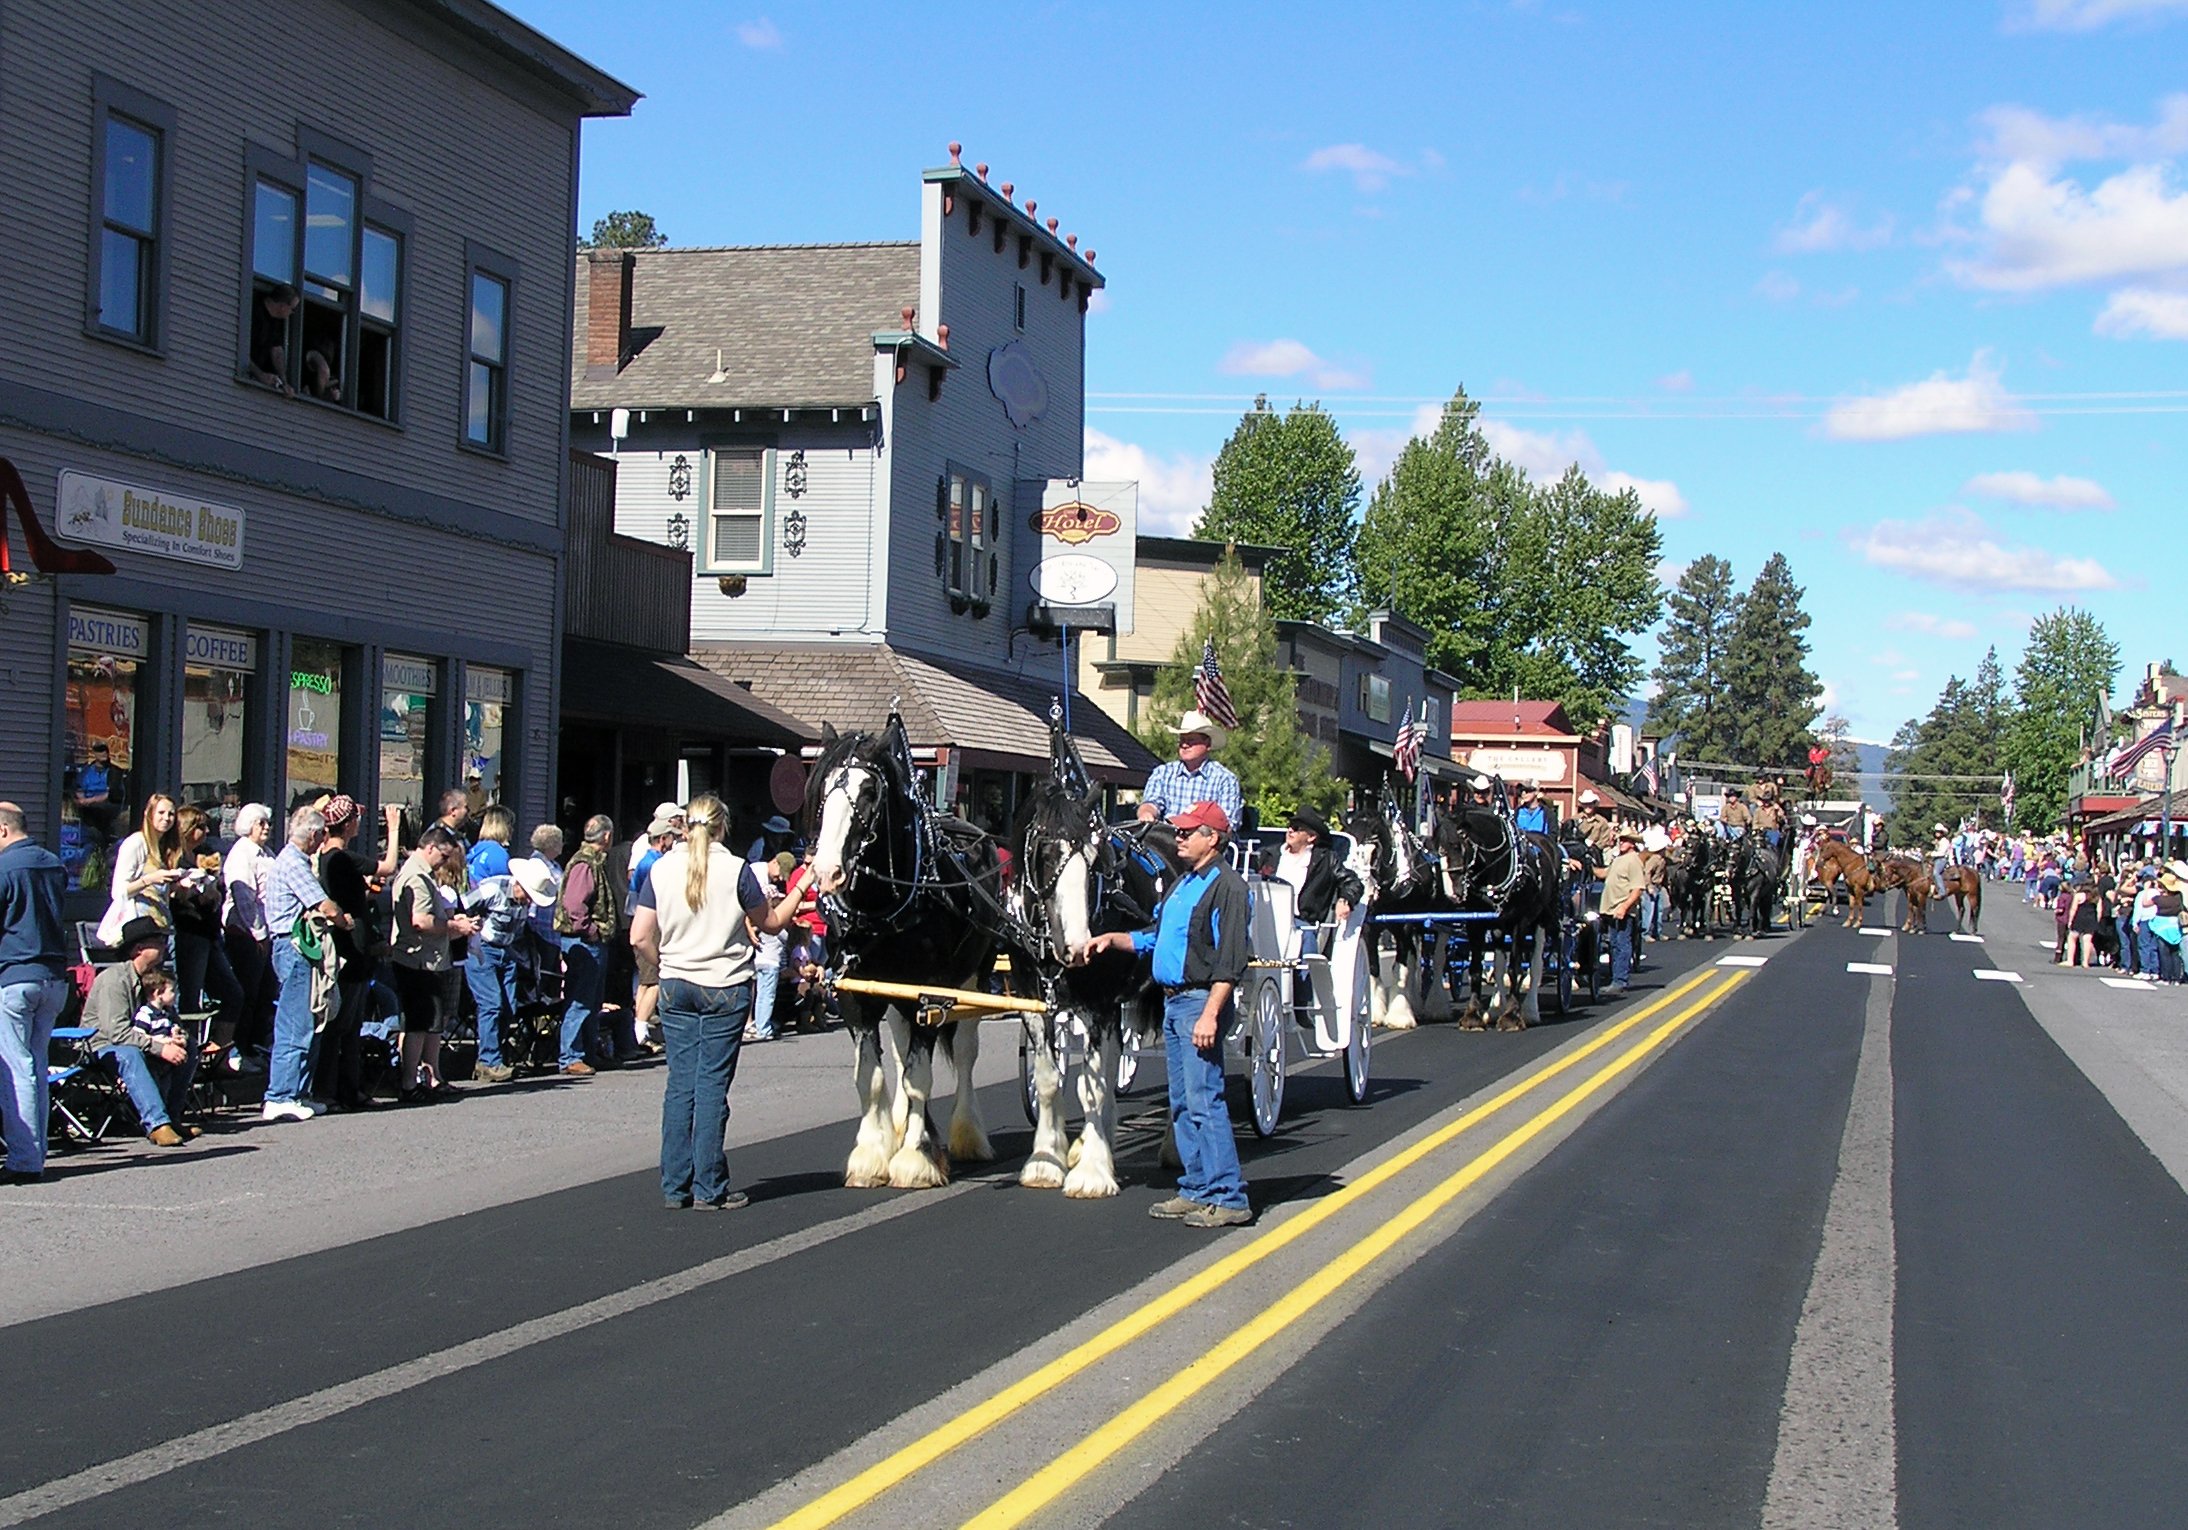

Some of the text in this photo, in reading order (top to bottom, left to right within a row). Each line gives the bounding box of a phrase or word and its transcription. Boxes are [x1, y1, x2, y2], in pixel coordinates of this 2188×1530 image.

[122, 490, 238, 547] Sundance Shoes
[122, 530, 170, 552] Specializing
[182, 543, 212, 557] Comfort
[213, 549, 236, 562] Shoes
[69, 616, 140, 649] PASTRIES
[186, 634, 248, 663] COFFEE
[290, 671, 332, 695] SPRESSO
[383, 663, 431, 688] MOOTHIES
[293, 729, 329, 748] PASTRY
